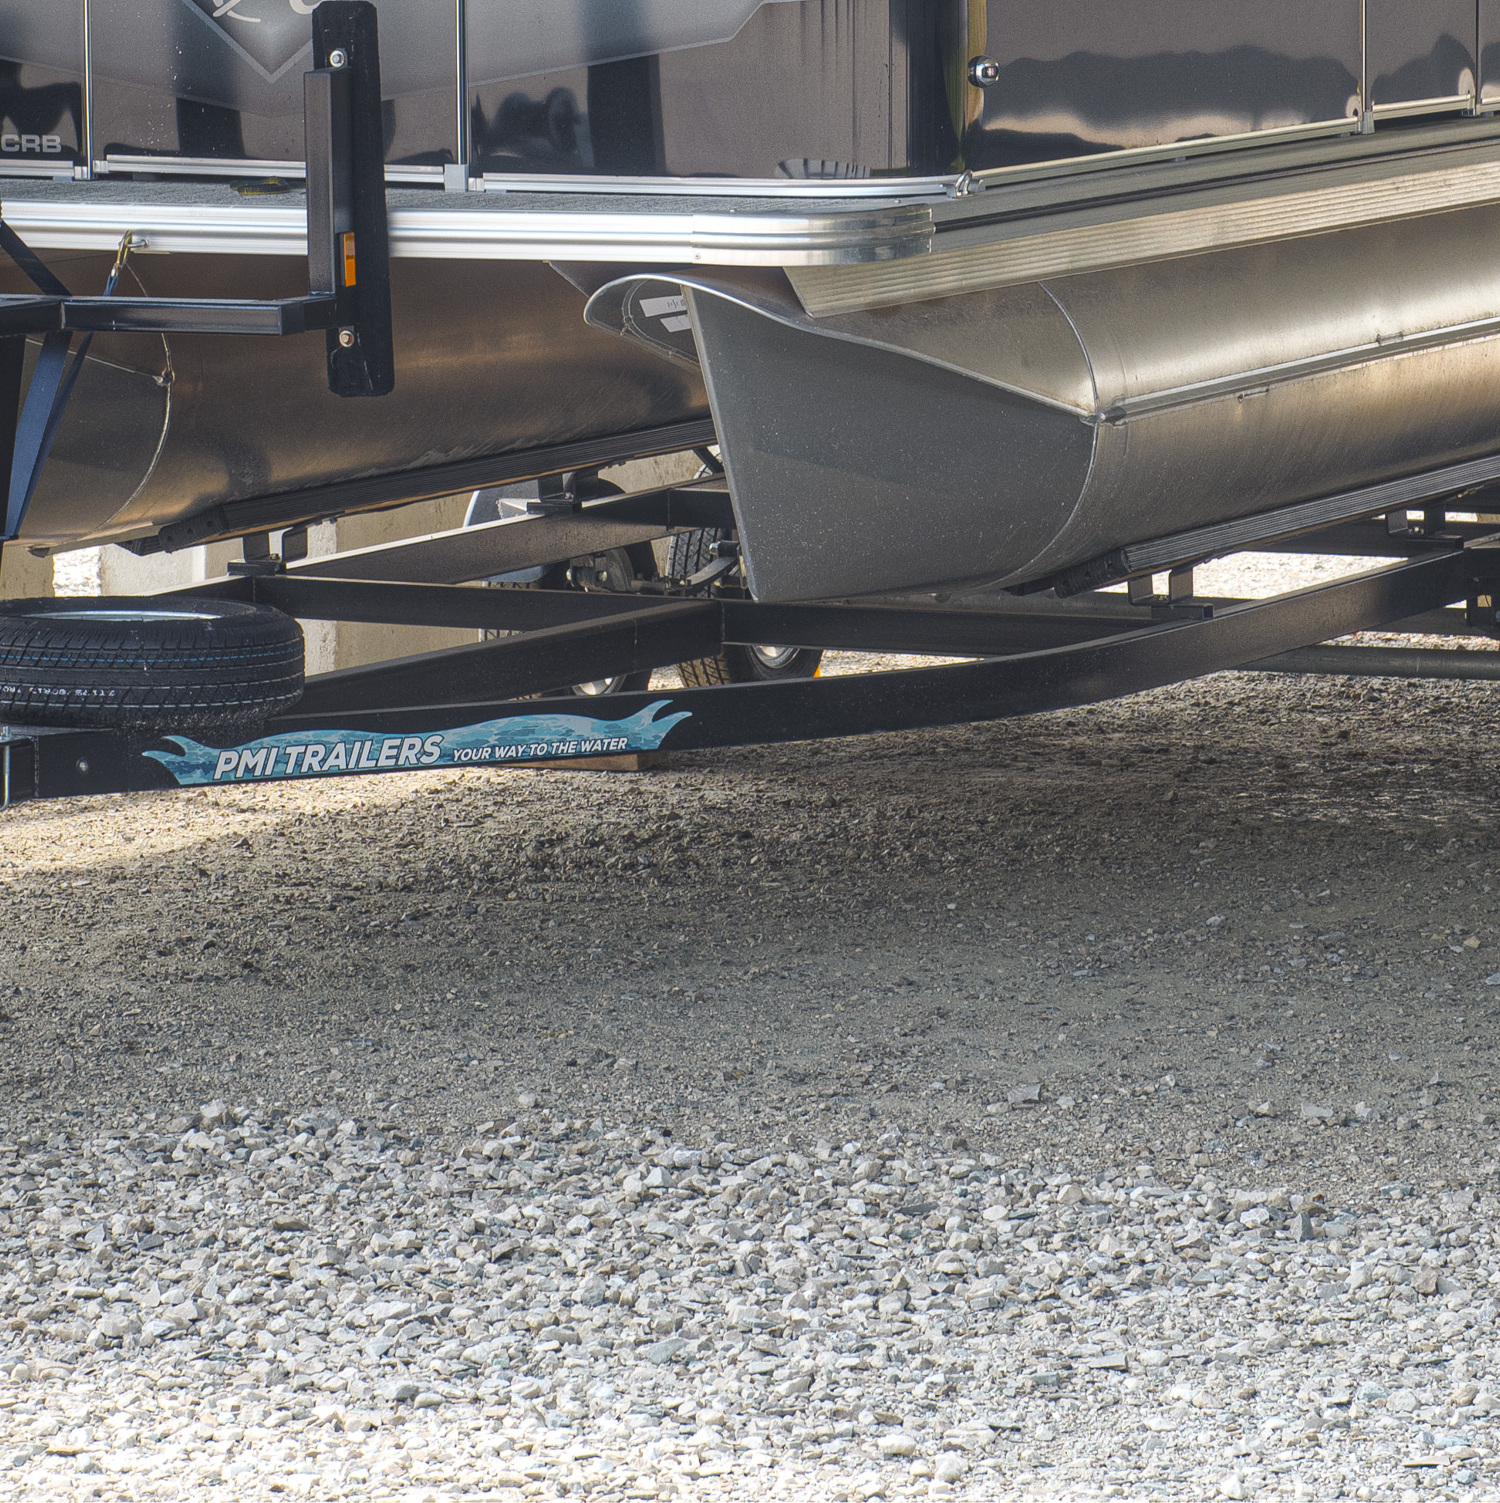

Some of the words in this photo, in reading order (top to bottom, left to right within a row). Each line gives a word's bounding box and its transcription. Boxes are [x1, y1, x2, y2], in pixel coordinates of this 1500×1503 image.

[1, 134, 63, 154] CRB
[212, 746, 280, 781] PMI
[283, 733, 445, 775] TRAILERS
[452, 746, 492, 762] YOUR
[494, 744, 527, 759] WAY
[528, 742, 549, 757] TO
[551, 740, 578, 755] THE
[580, 736, 628, 752] WATER
